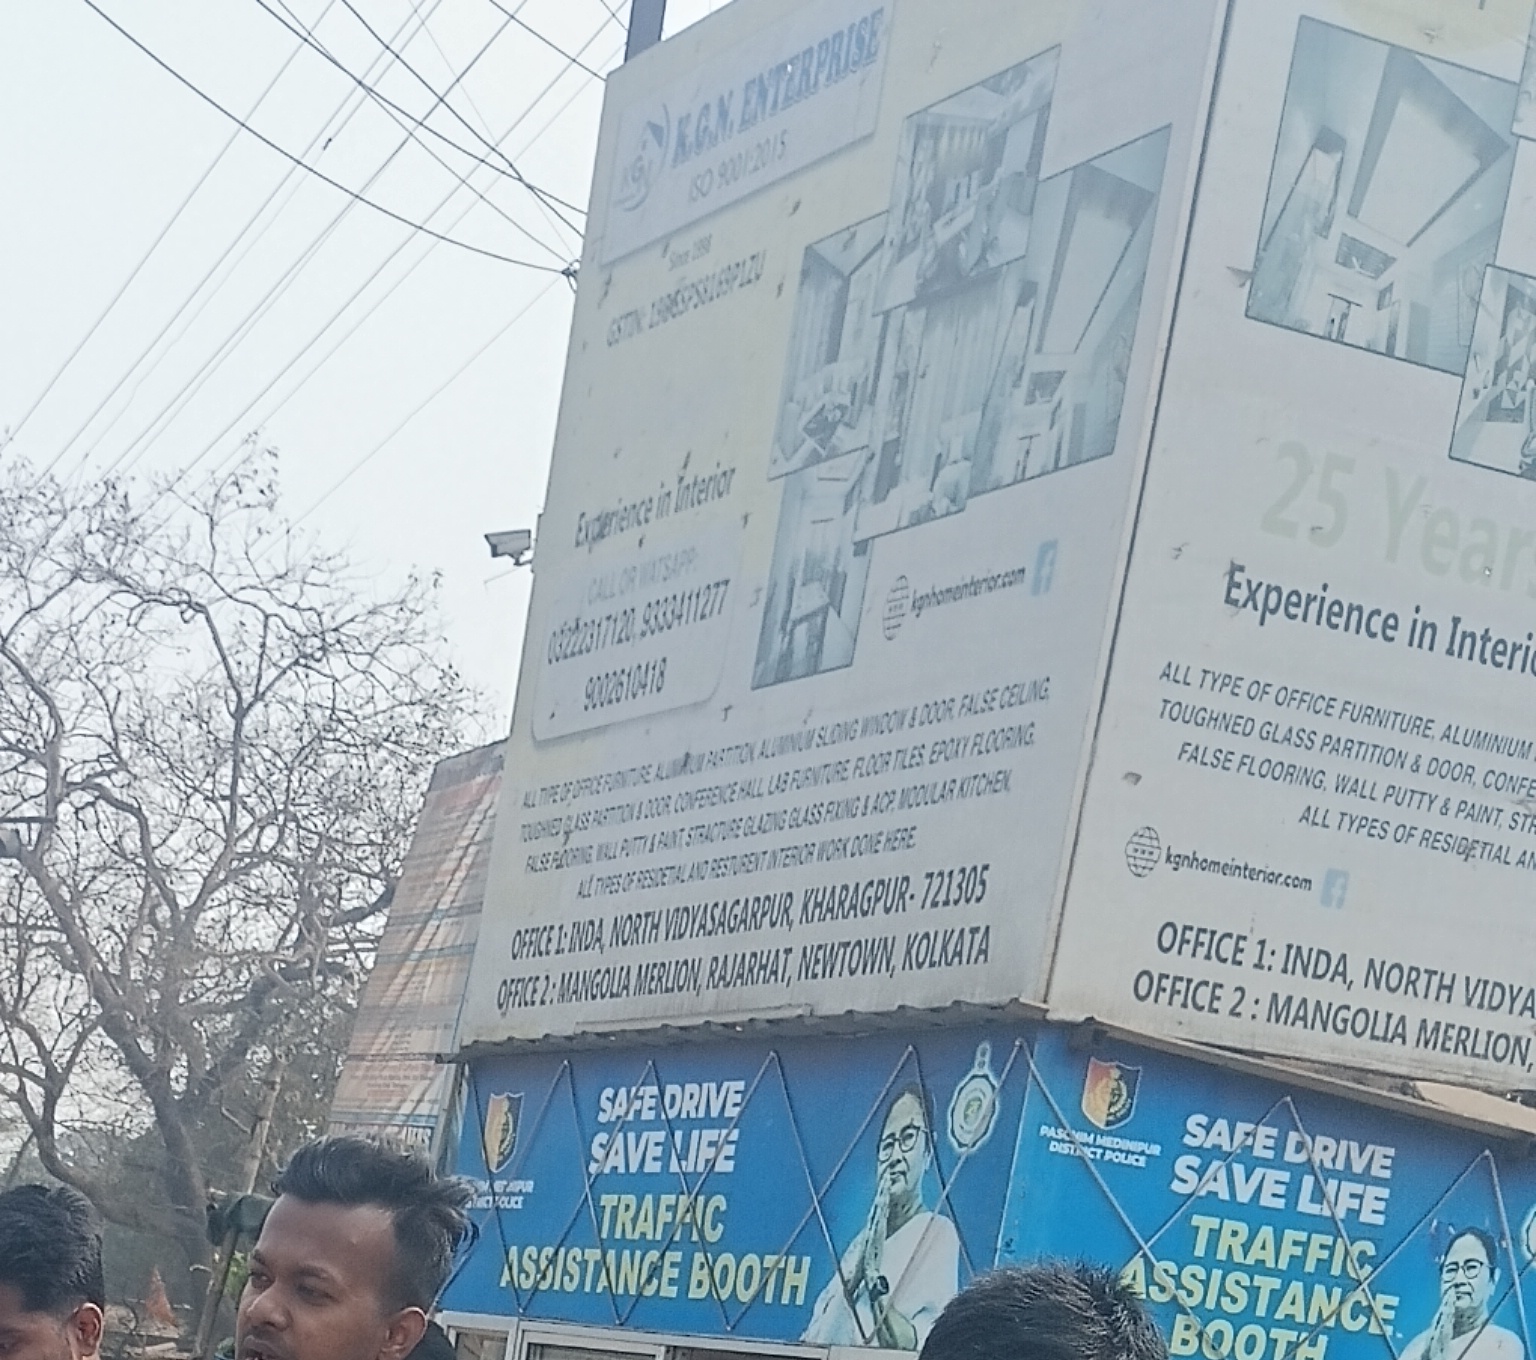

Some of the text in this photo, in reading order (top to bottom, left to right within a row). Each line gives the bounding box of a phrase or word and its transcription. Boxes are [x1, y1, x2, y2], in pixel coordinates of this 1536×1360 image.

[737, 6, 884, 134] ENTERPRISE
[656, 480, 672, 519] in
[675, 461, 735, 513] Interior
[1261, 440, 1356, 547] 25
[1223, 560, 1399, 643] Experience
[1408, 605, 1437, 652] in
[1159, 661, 1192, 687] ALL
[1199, 669, 1244, 697] TYPE
[1247, 680, 1273, 702] OF
[1274, 686, 1338, 717] OFFICE
[1440, 723, 1534, 761] ALUMINIUM
[1159, 698, 1255, 738] TOUGHNED
[1258, 720, 1317, 752] GLASS
[1320, 734, 1409, 771] PARTITION
[1410, 754, 1422, 774] &
[1426, 757, 1476, 788] DOOR,
[1177, 741, 1235, 771] FALSE
[1334, 772, 1378, 802] WALL
[1383, 784, 1439, 813] PUTTY
[1439, 797, 1451, 816] &
[1454, 800, 1504, 829] PAINT,
[1165, 845, 1313, 891] kgnhomeinterior.com
[1298, 804, 1331, 829] ALL
[1336, 811, 1390, 841] TYPES
[1393, 823, 1418, 845] OF
[1418, 828, 1511, 866] RESIDETIAL
[511, 924, 555, 961] OFFICE
[568, 916, 606, 955] INDA,
[609, 909, 663, 948] NORTH
[663, 887, 794, 942] VIDYASAGARPUR,
[920, 863, 990, 911] 721305
[497, 924, 991, 1010] OFFICE MANGOLIA MERLION, RAJARHAT, NEWTOWN, KOLKATA
[1157, 921, 1248, 968] OFFICE
[1252, 938, 1277, 973] 1:
[1280, 943, 1355, 992] INDA,
[1364, 957, 1457, 1005] NORTH
[1133, 969, 1535, 1074] OFFICE 2 MANGOLIA MERLION,
[597, 1080, 746, 1124] SAFE DRIVE
[588, 1129, 740, 1175] SAVE LIFE
[1104, 1149, 1147, 1169] POLICE
[1182, 1113, 1396, 1179] SAFE DRIVE
[599, 1194, 727, 1243] TRAFFIC
[1170, 1154, 1391, 1226] SAVE LIFE
[499, 1246, 812, 1307] ASSISTANCE BOOTH
[1190, 1213, 1377, 1282] TRAFFIC
[1120, 1256, 1401, 1338] ASSISTANCE
